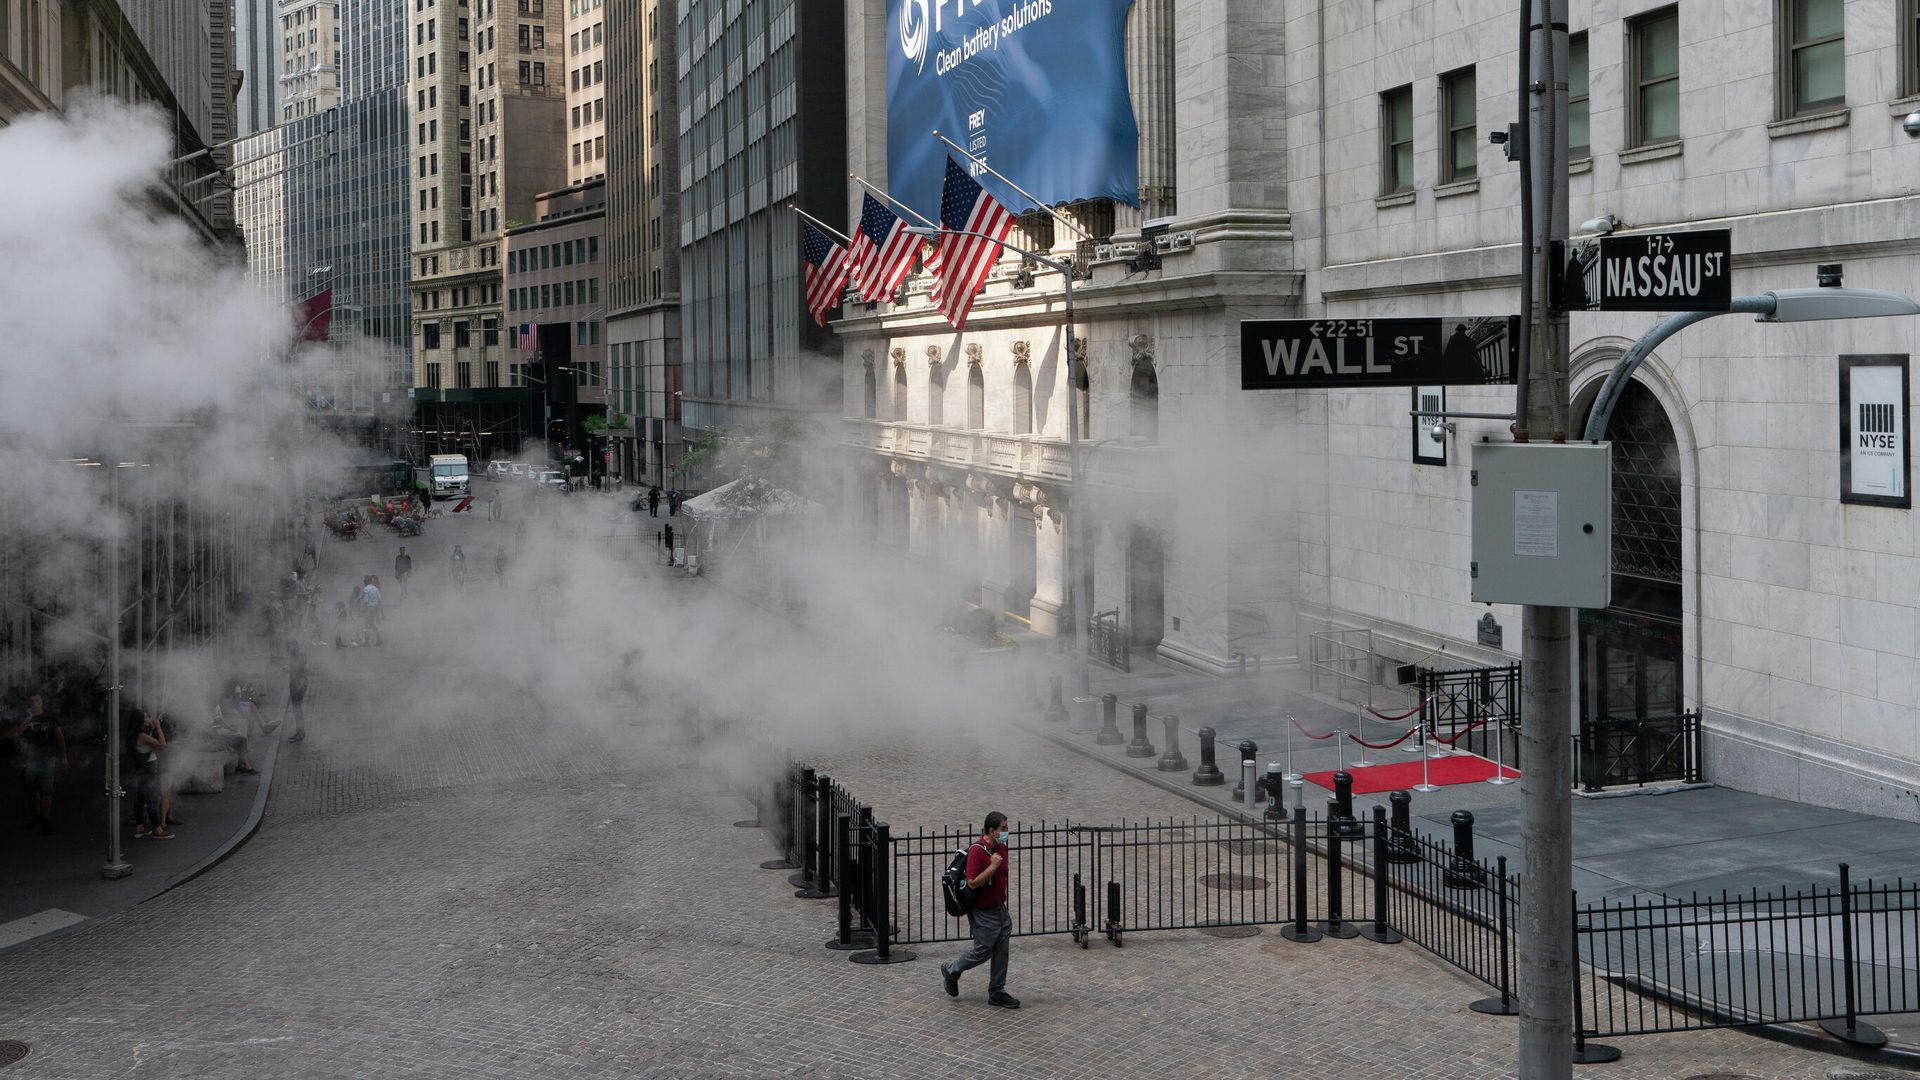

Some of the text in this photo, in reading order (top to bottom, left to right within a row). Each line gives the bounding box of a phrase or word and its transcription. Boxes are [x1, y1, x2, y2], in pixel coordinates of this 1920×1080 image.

[936, 47, 962, 76] Clean
[963, 22, 1000, 61] battery
[1001, 0, 1052, 38] solutions
[969, 108, 985, 131] FREY
[969, 135, 987, 152] LISTED
[1646, 236, 1662, 255] 1-7
[1606, 252, 1724, 297] NASSAU ST
[1326, 320, 1373, 338] 22-51
[1261, 335, 1424, 376] WALL ST
[1860, 434, 1895, 449] NYSE
